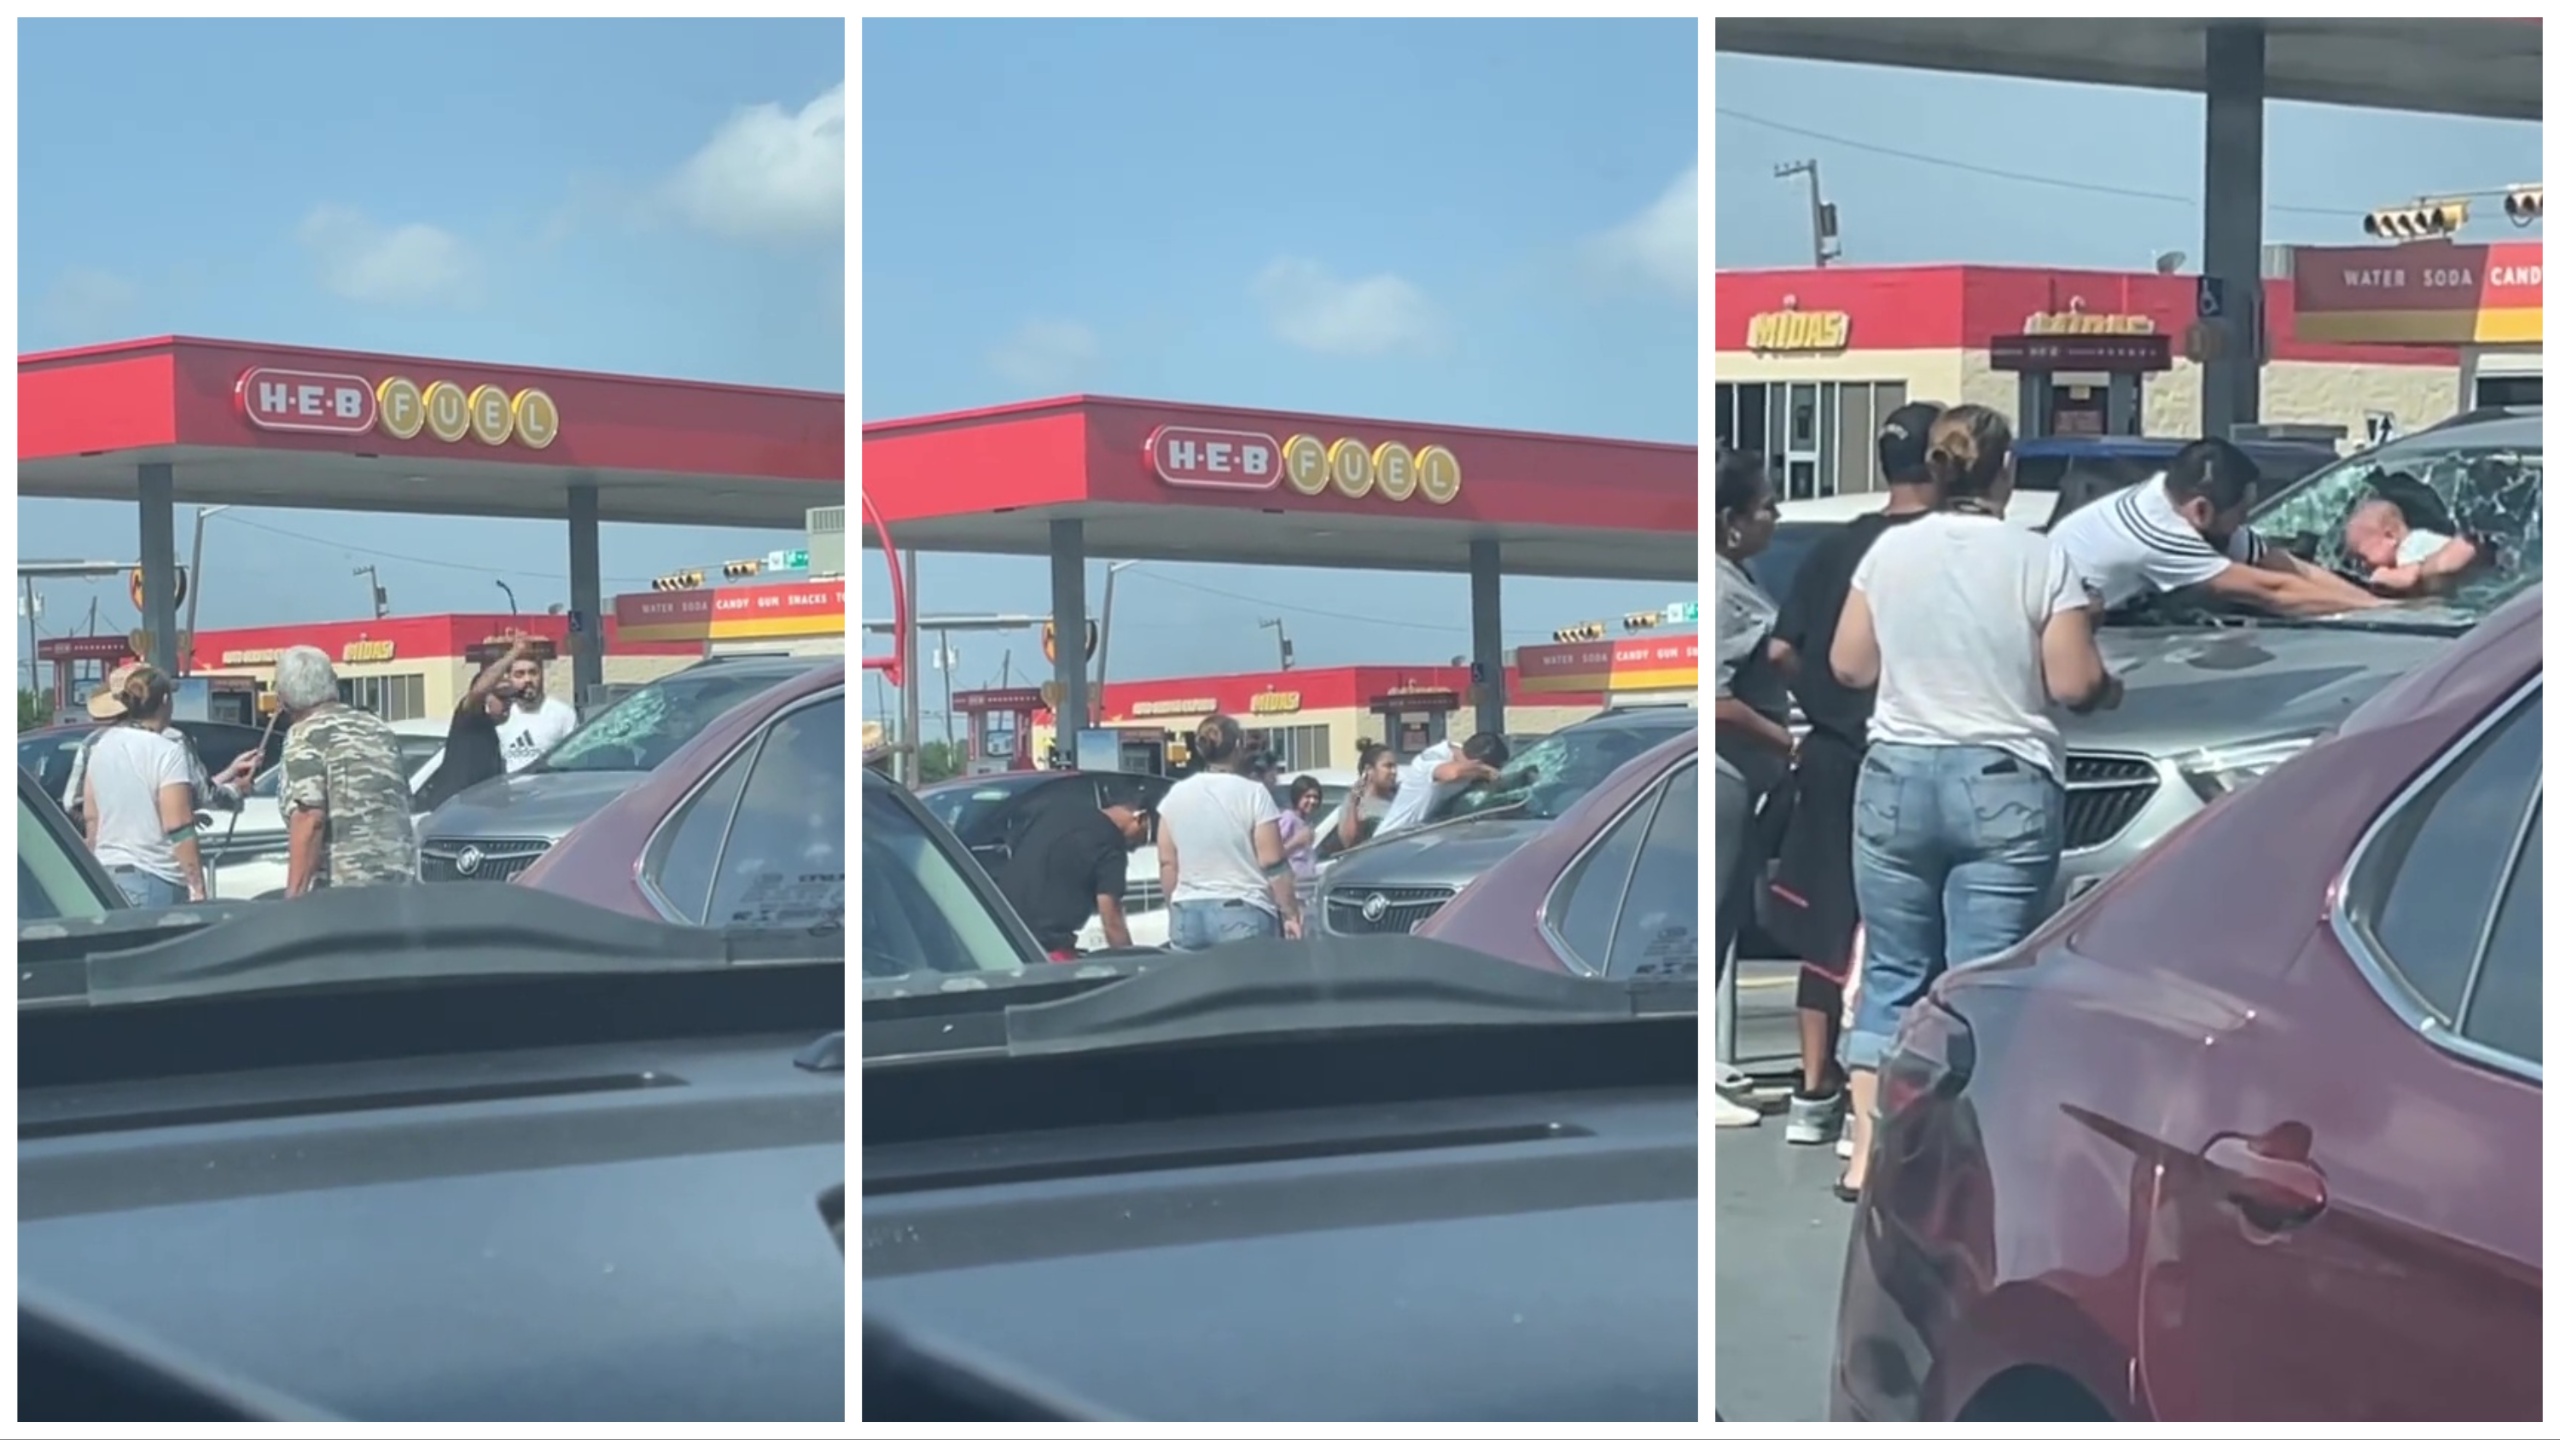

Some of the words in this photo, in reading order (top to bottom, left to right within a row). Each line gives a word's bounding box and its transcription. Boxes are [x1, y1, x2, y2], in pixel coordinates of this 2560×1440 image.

[2343, 269, 2406, 288] WATER
[2423, 268, 2473, 287] SODA
[1746, 310, 1849, 349] MIDAS
[393, 392, 545, 433] FUEL
[1299, 448, 1448, 489] FUEL
[641, 603, 674, 614] WATER
[681, 601, 709, 612] SODA
[716, 598, 750, 611] CANDY
[788, 593, 828, 606] SNACKS
[1542, 653, 1574, 665] WATER
[1582, 652, 1608, 663] SODA
[1616, 650, 1650, 662] CANDY
